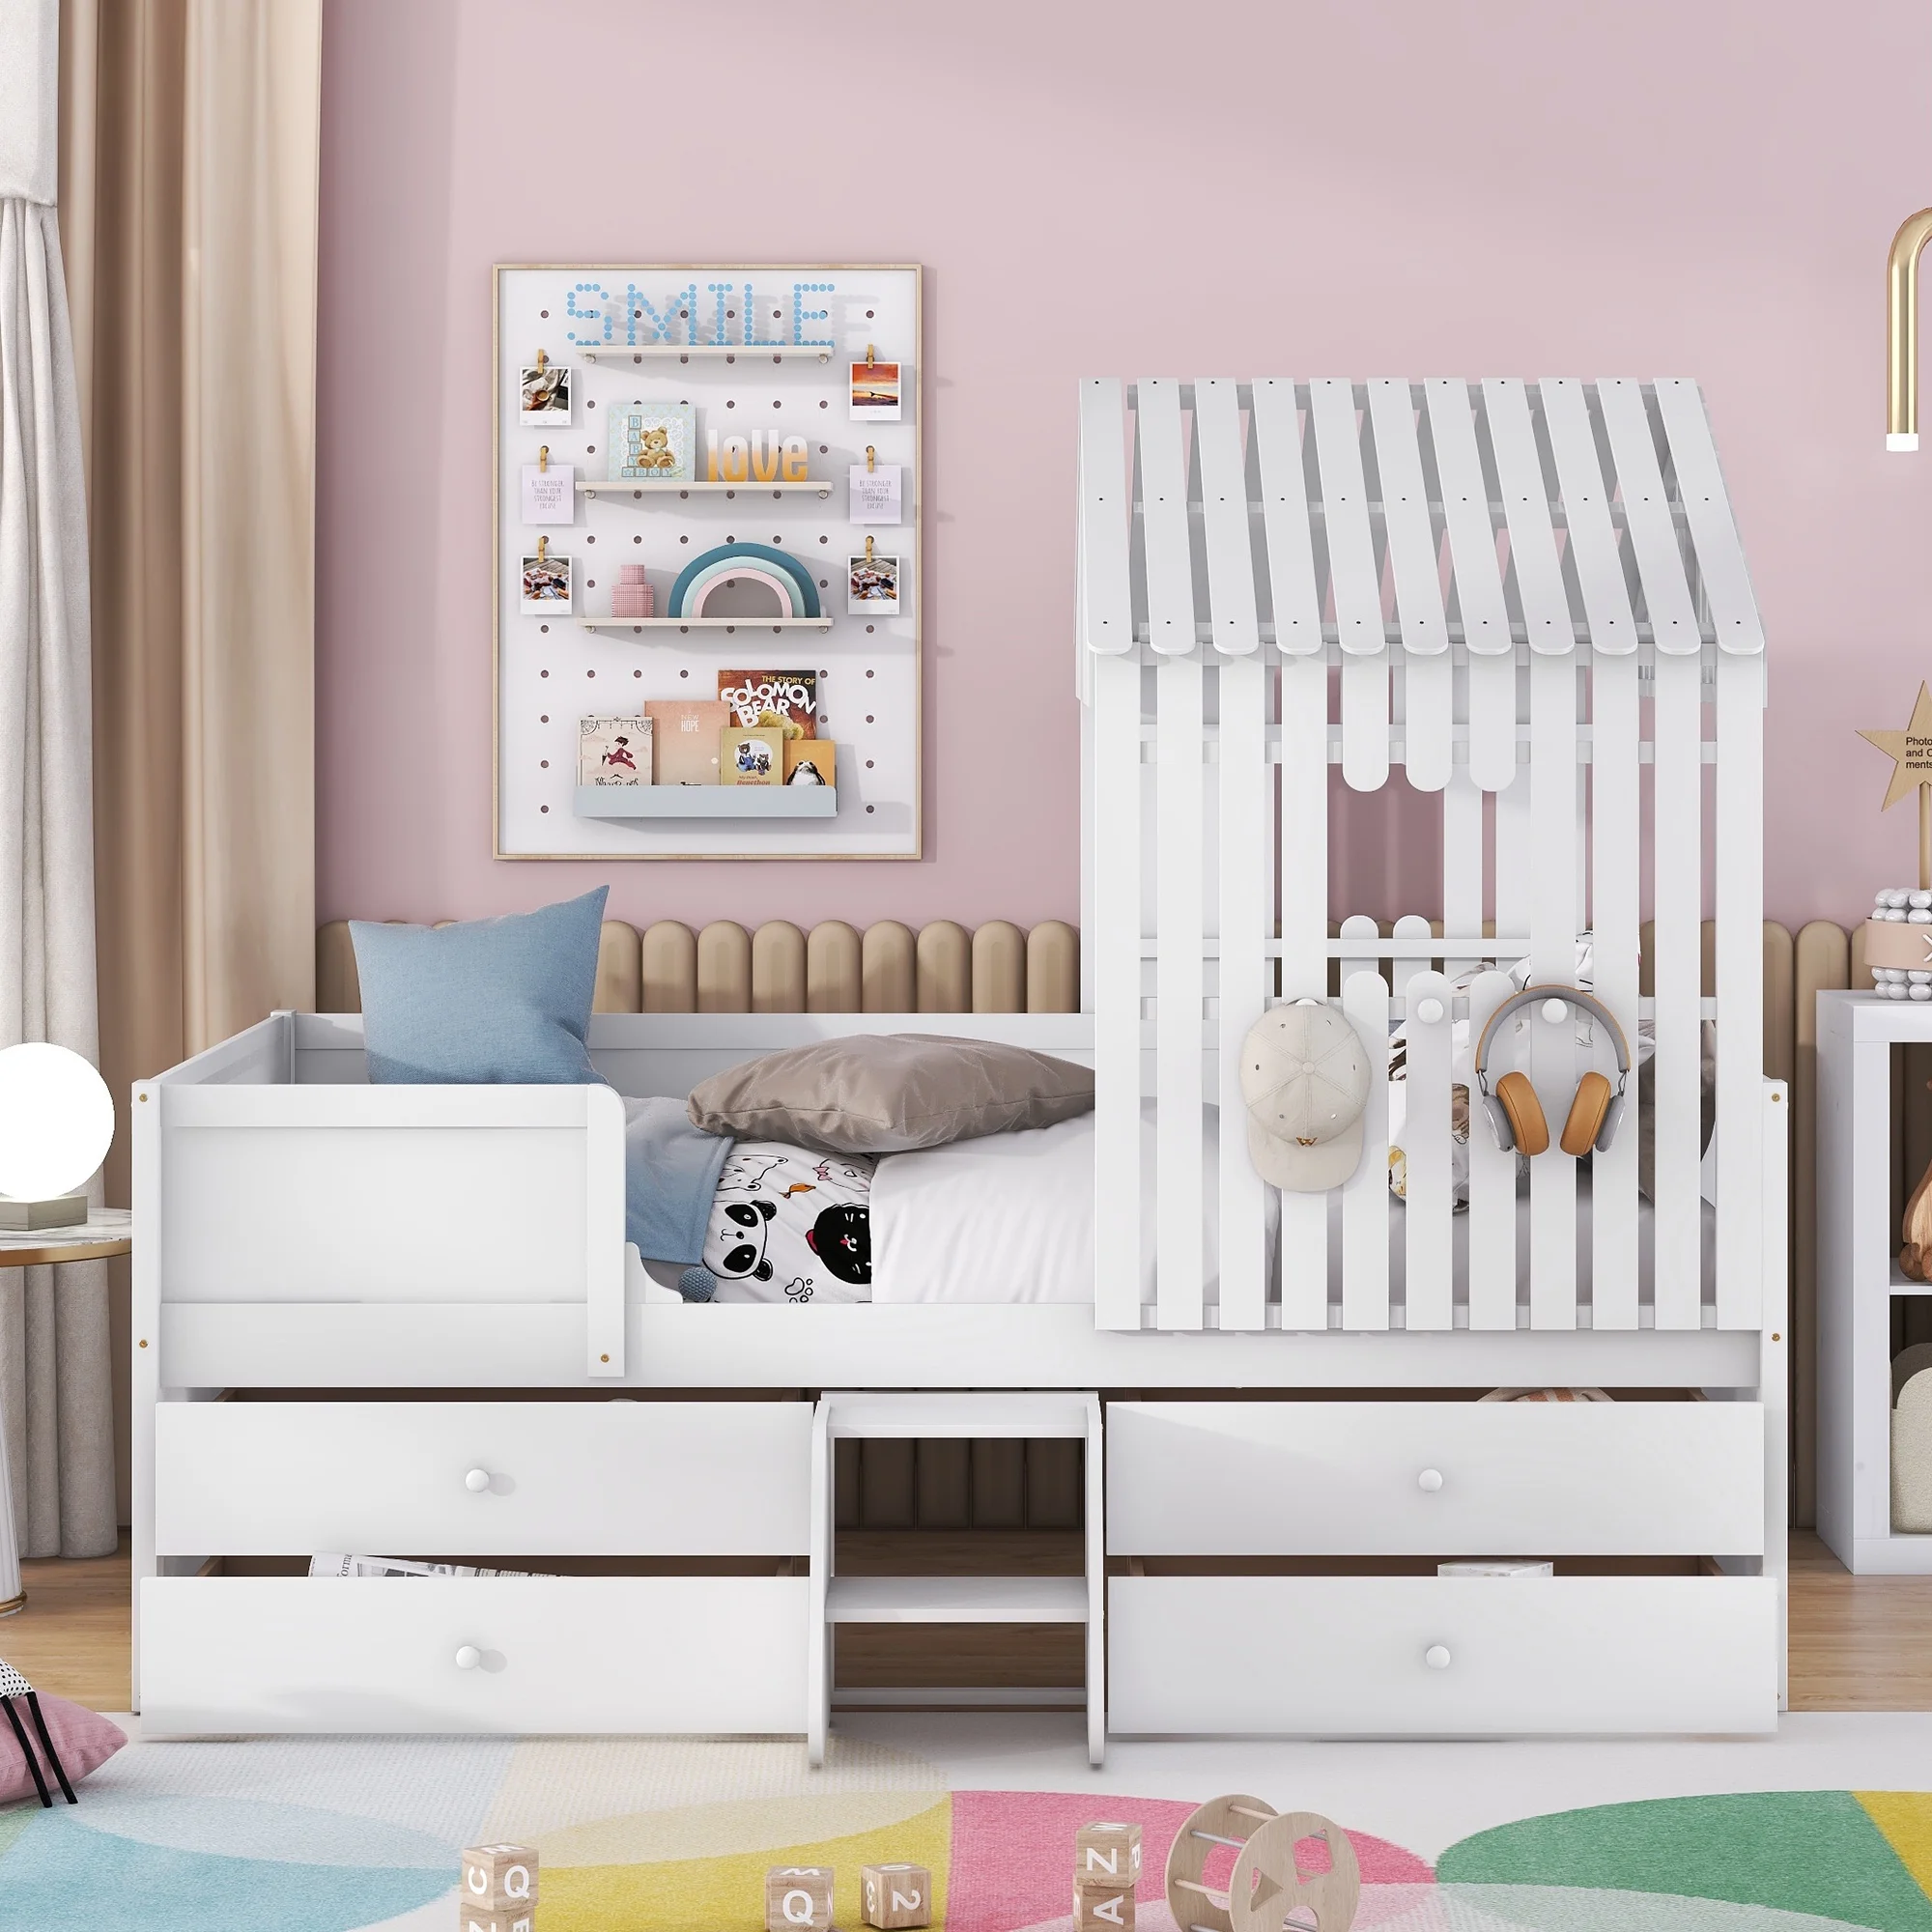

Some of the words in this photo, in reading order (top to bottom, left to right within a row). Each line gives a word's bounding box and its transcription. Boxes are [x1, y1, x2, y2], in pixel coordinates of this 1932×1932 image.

[567, 283, 836, 346] SMILE
[721, 678, 817, 715] SOLOMON
[736, 696, 790, 728] BEAR
[681, 720, 700, 732] HOPE
[468, 1865, 488, 1895] C
[504, 1864, 530, 1898] Q
[782, 1889, 814, 1926] Q
[892, 1889, 921, 1912] 2
[1093, 1894, 1124, 1925] A
